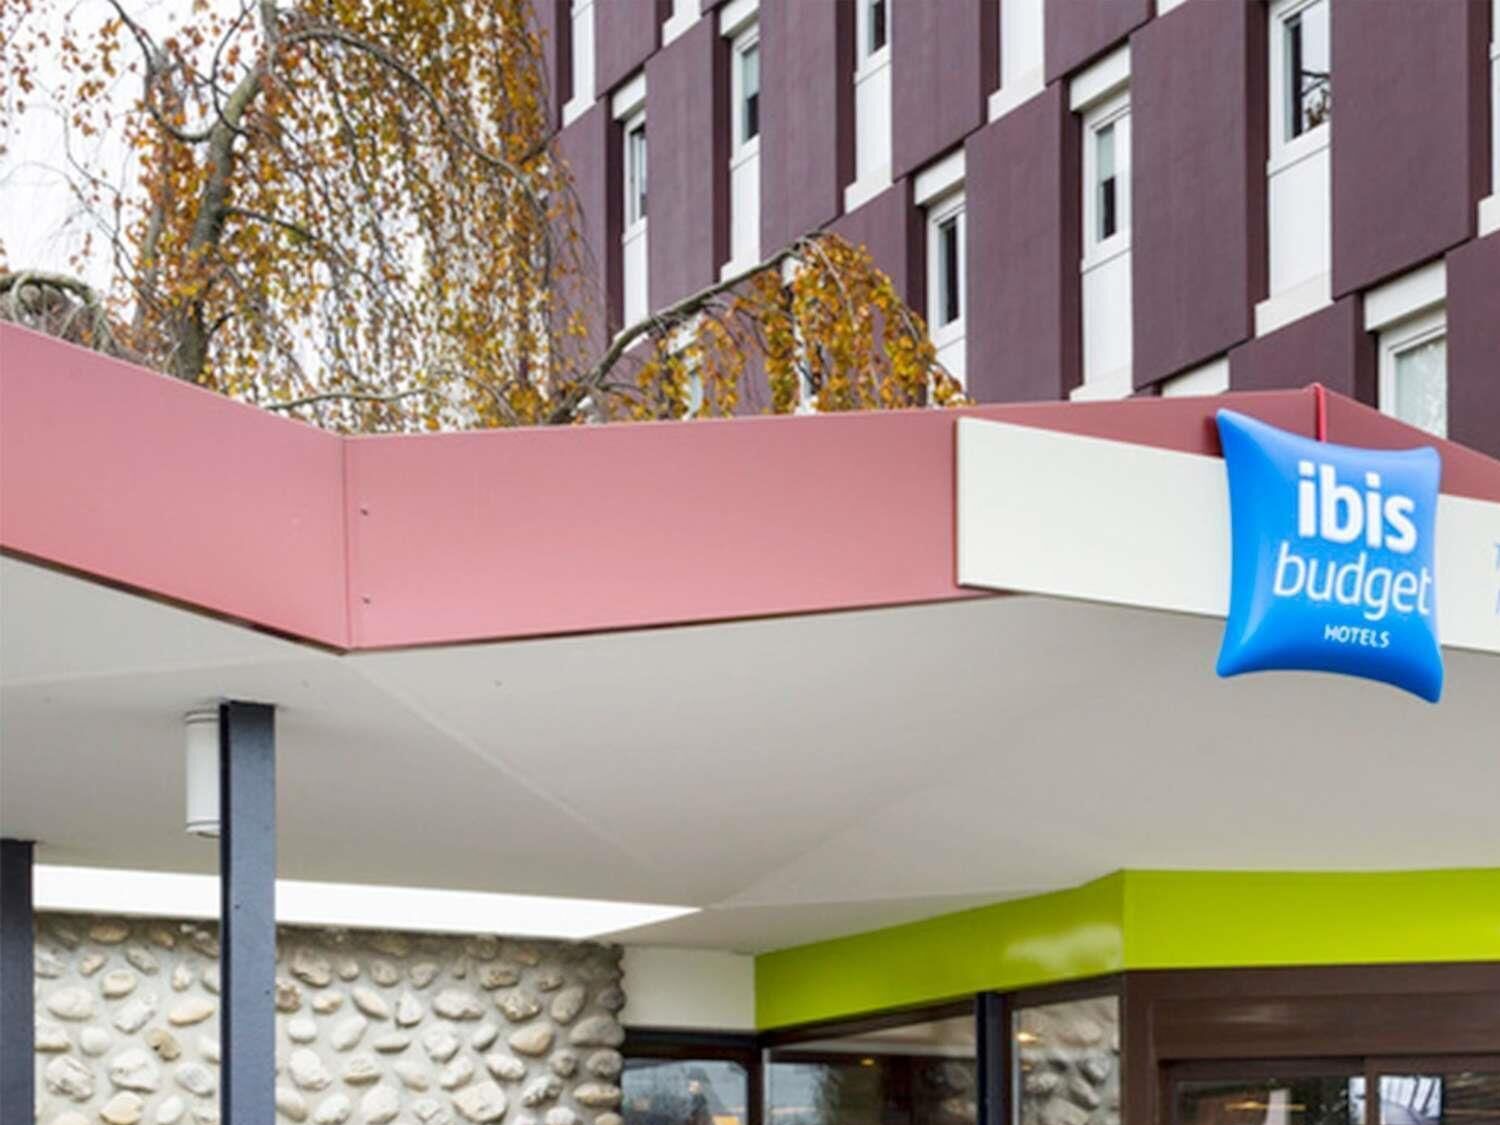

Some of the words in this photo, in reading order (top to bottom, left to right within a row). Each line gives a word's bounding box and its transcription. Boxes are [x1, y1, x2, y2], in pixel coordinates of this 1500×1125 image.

[1298, 460, 1416, 554] ibis
[1273, 540, 1431, 621] budget
[1324, 624, 1390, 648] HOTELS
